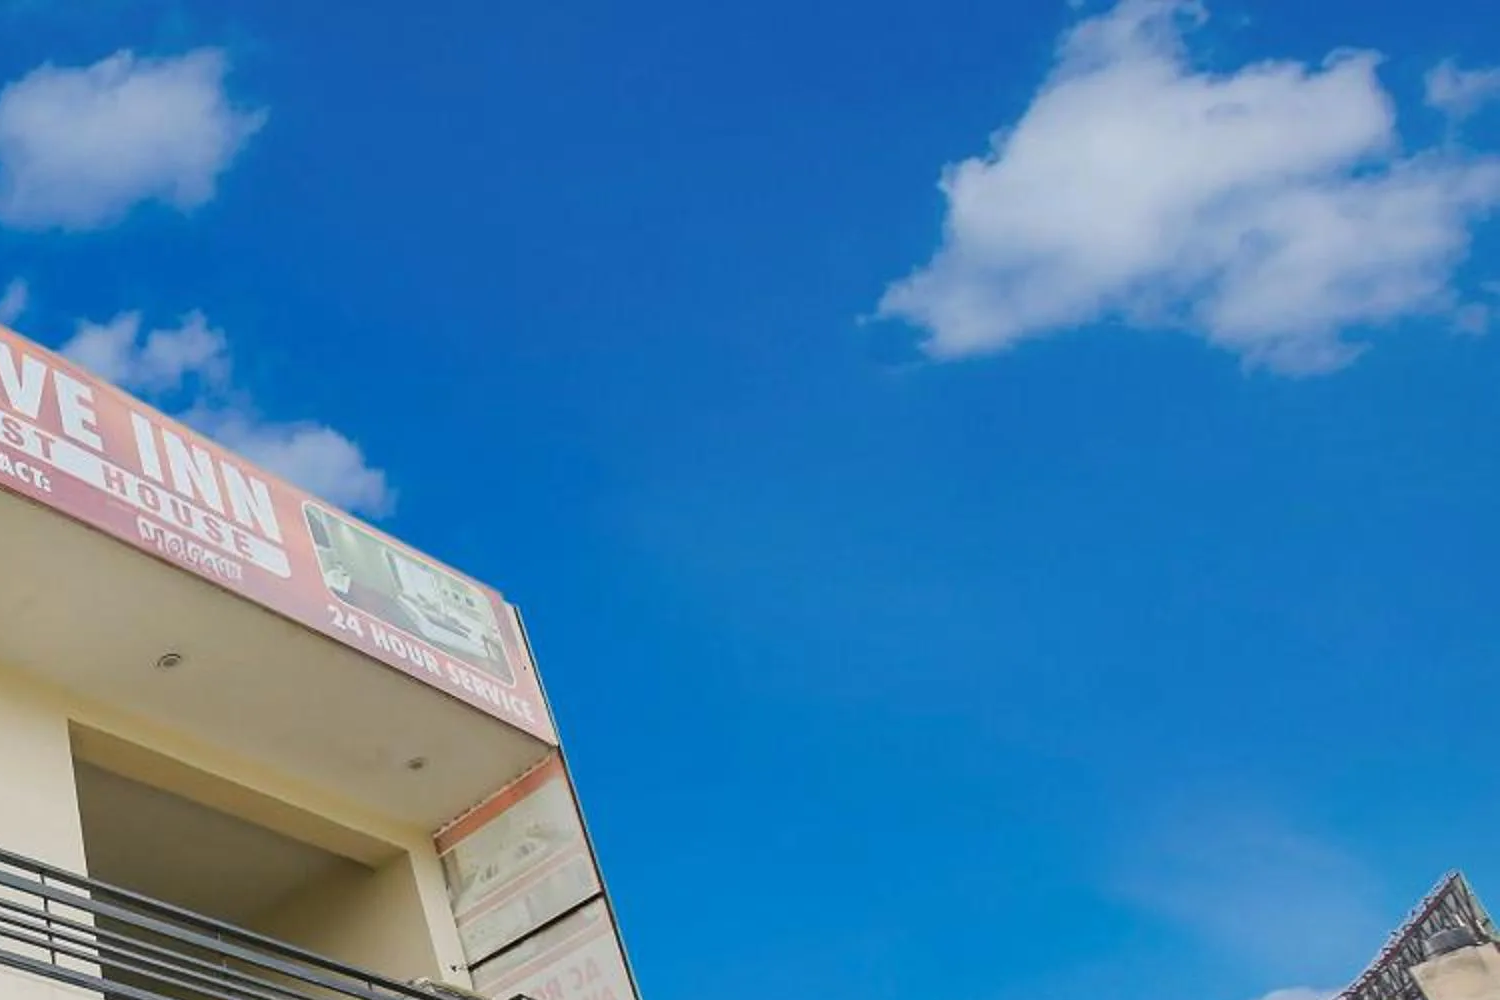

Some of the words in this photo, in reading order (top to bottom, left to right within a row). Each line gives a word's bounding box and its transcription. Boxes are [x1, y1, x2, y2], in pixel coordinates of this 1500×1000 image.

[103, 464, 255, 559] HOUSE
[131, 412, 281, 543] INN
[327, 605, 363, 638] 24
[370, 623, 441, 676] HOUR
[447, 662, 535, 725] SERVICE
